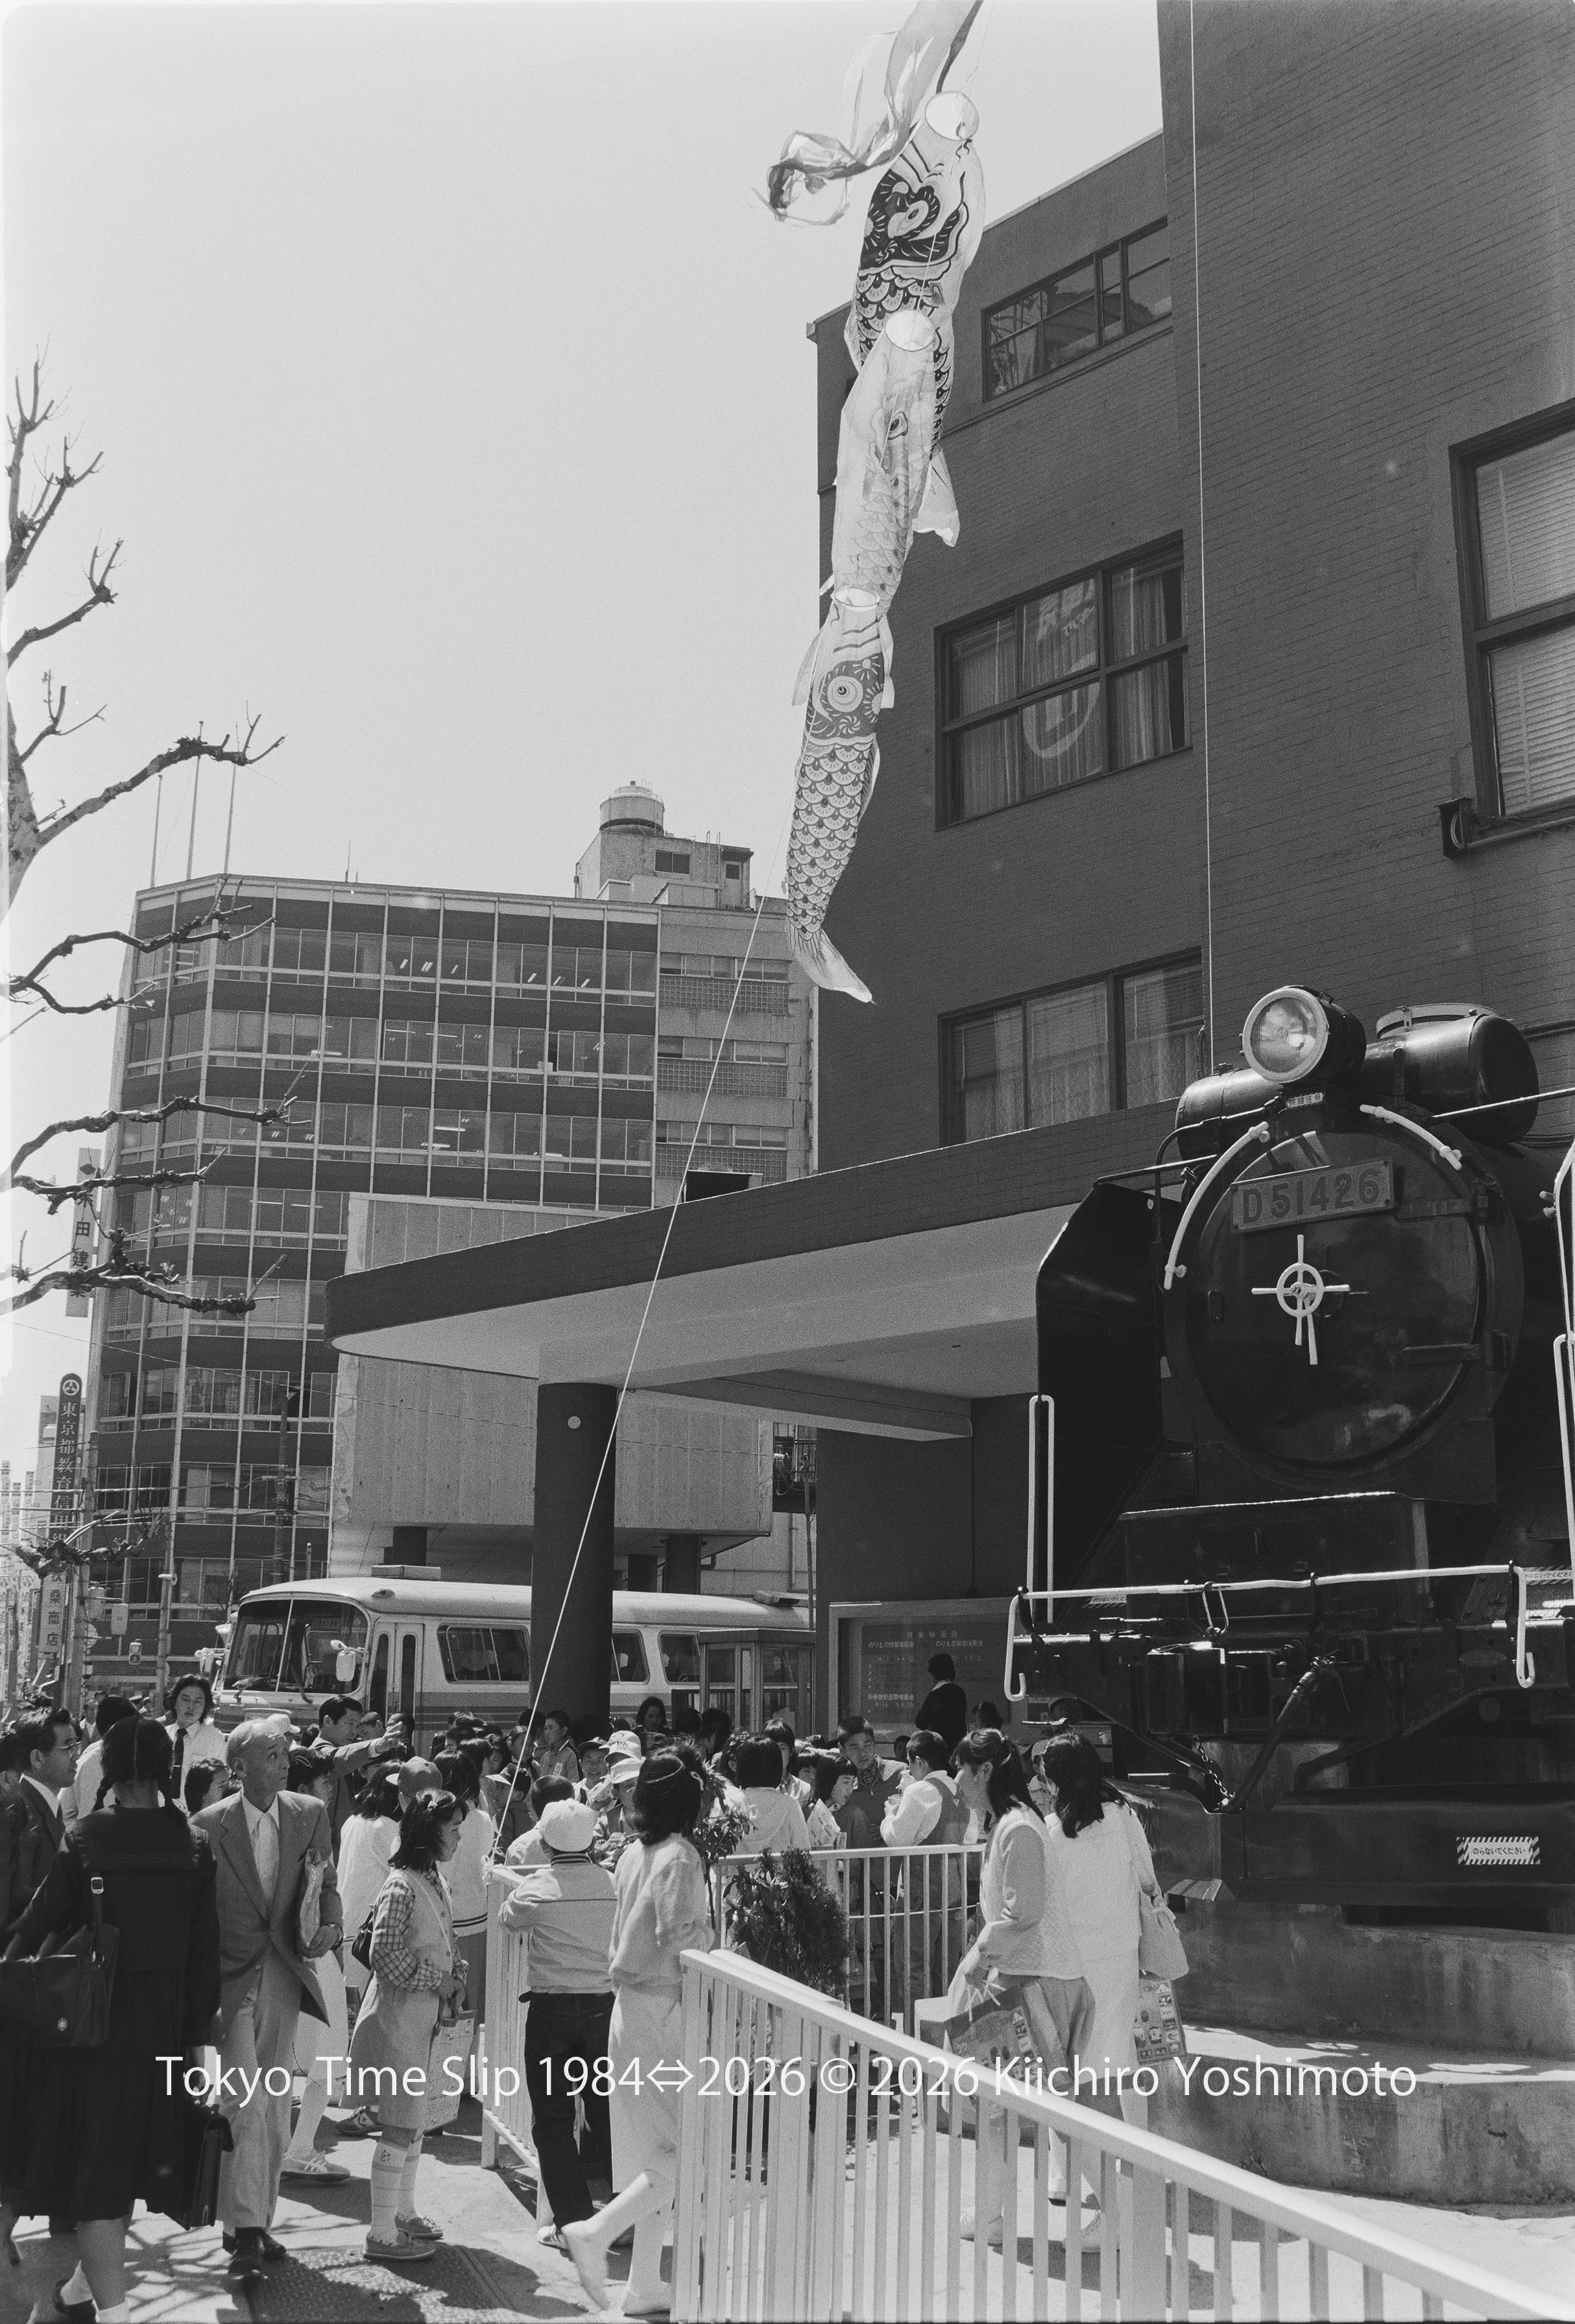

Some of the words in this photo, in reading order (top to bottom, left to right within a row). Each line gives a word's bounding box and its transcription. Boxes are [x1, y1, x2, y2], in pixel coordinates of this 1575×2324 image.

[1242, 1168, 1380, 1224] D51426
[52, 1402, 77, 1568] 東京都教育信用組
[1473, 1847, 1526, 1856] のらないでください
